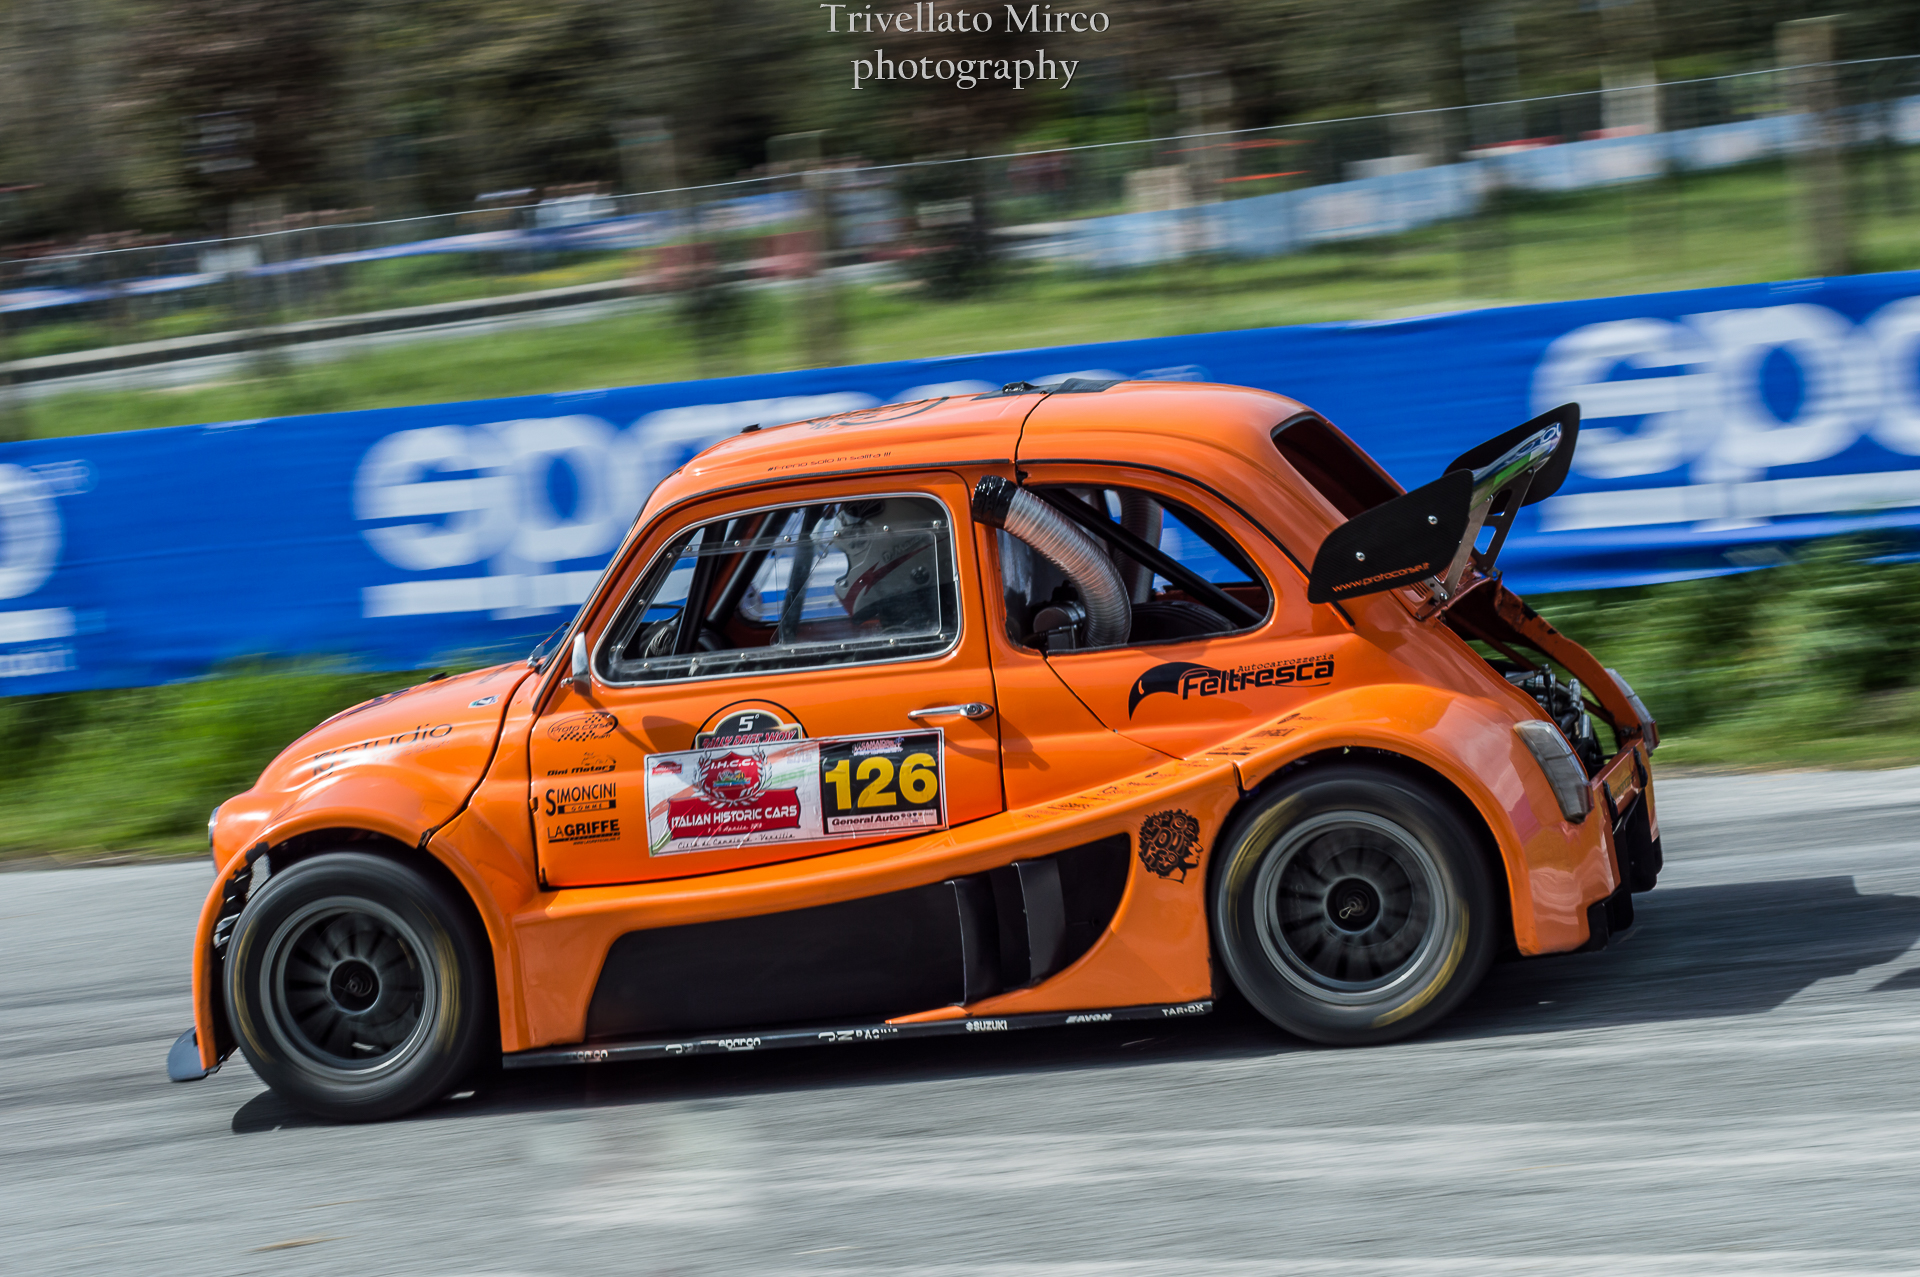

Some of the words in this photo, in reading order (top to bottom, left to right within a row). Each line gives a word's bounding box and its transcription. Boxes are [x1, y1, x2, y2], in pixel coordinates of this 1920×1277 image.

[1237, 653, 1335, 673] Autocarrozzeria
[1182, 660, 1335, 700] Feltresca
[711, 758, 754, 769] I.H.C.C.
[825, 752, 938, 810] 126
[545, 782, 616, 817] SIMONCINI
[671, 812, 711, 828] ITALIAN
[713, 808, 762, 824] HISTORIC
[764, 805, 798, 819] CARS
[831, 815, 875, 826] General
[875, 814, 900, 823] Auto
[974, 1020, 1008, 1031] SUZUKI
[1076, 1013, 1112, 1023] AVON
